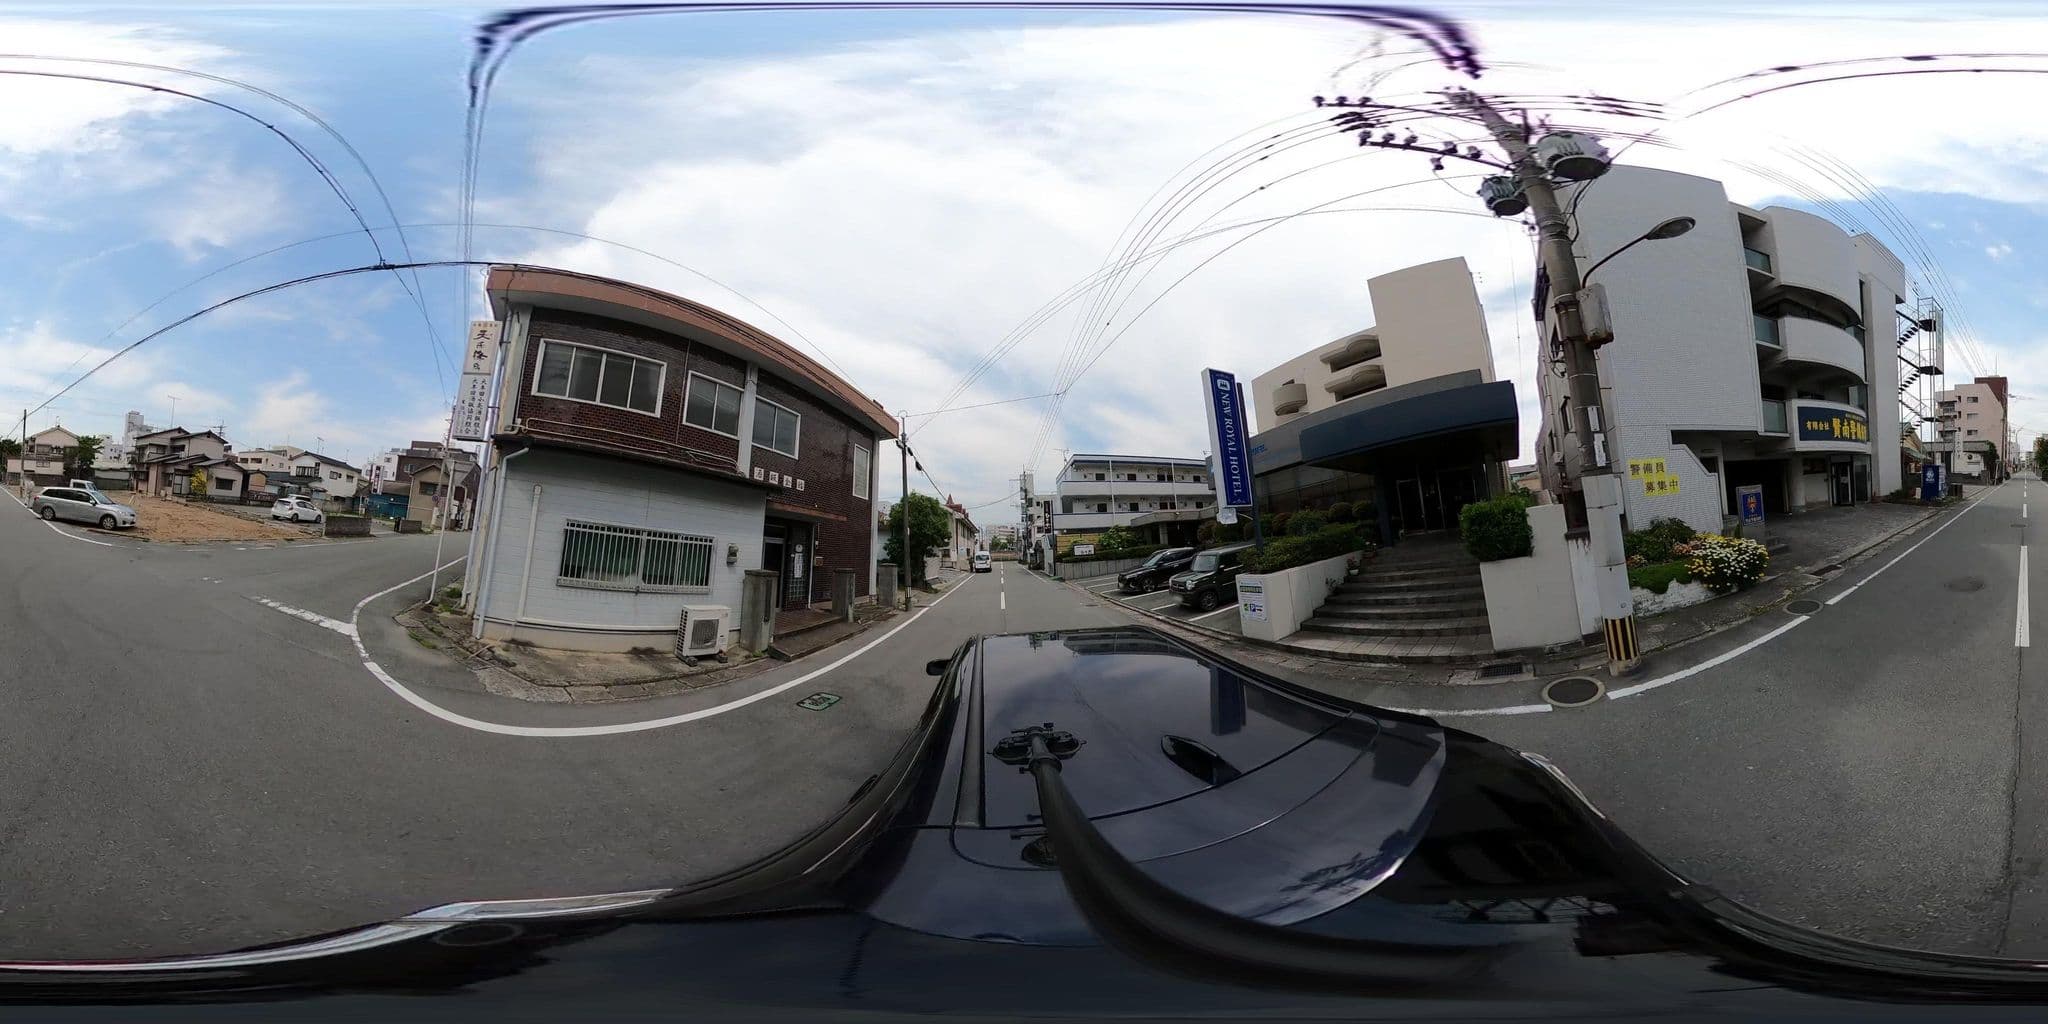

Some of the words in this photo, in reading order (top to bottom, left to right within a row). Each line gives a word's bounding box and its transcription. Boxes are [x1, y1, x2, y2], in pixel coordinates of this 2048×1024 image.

[1220, 390, 1232, 416] NEW
[1224, 418, 1237, 454] ROYAL
[1229, 456, 1242, 496] HOTEL
[1630, 462, 1664, 475] 警備員
[1646, 479, 1678, 493] 募集中
